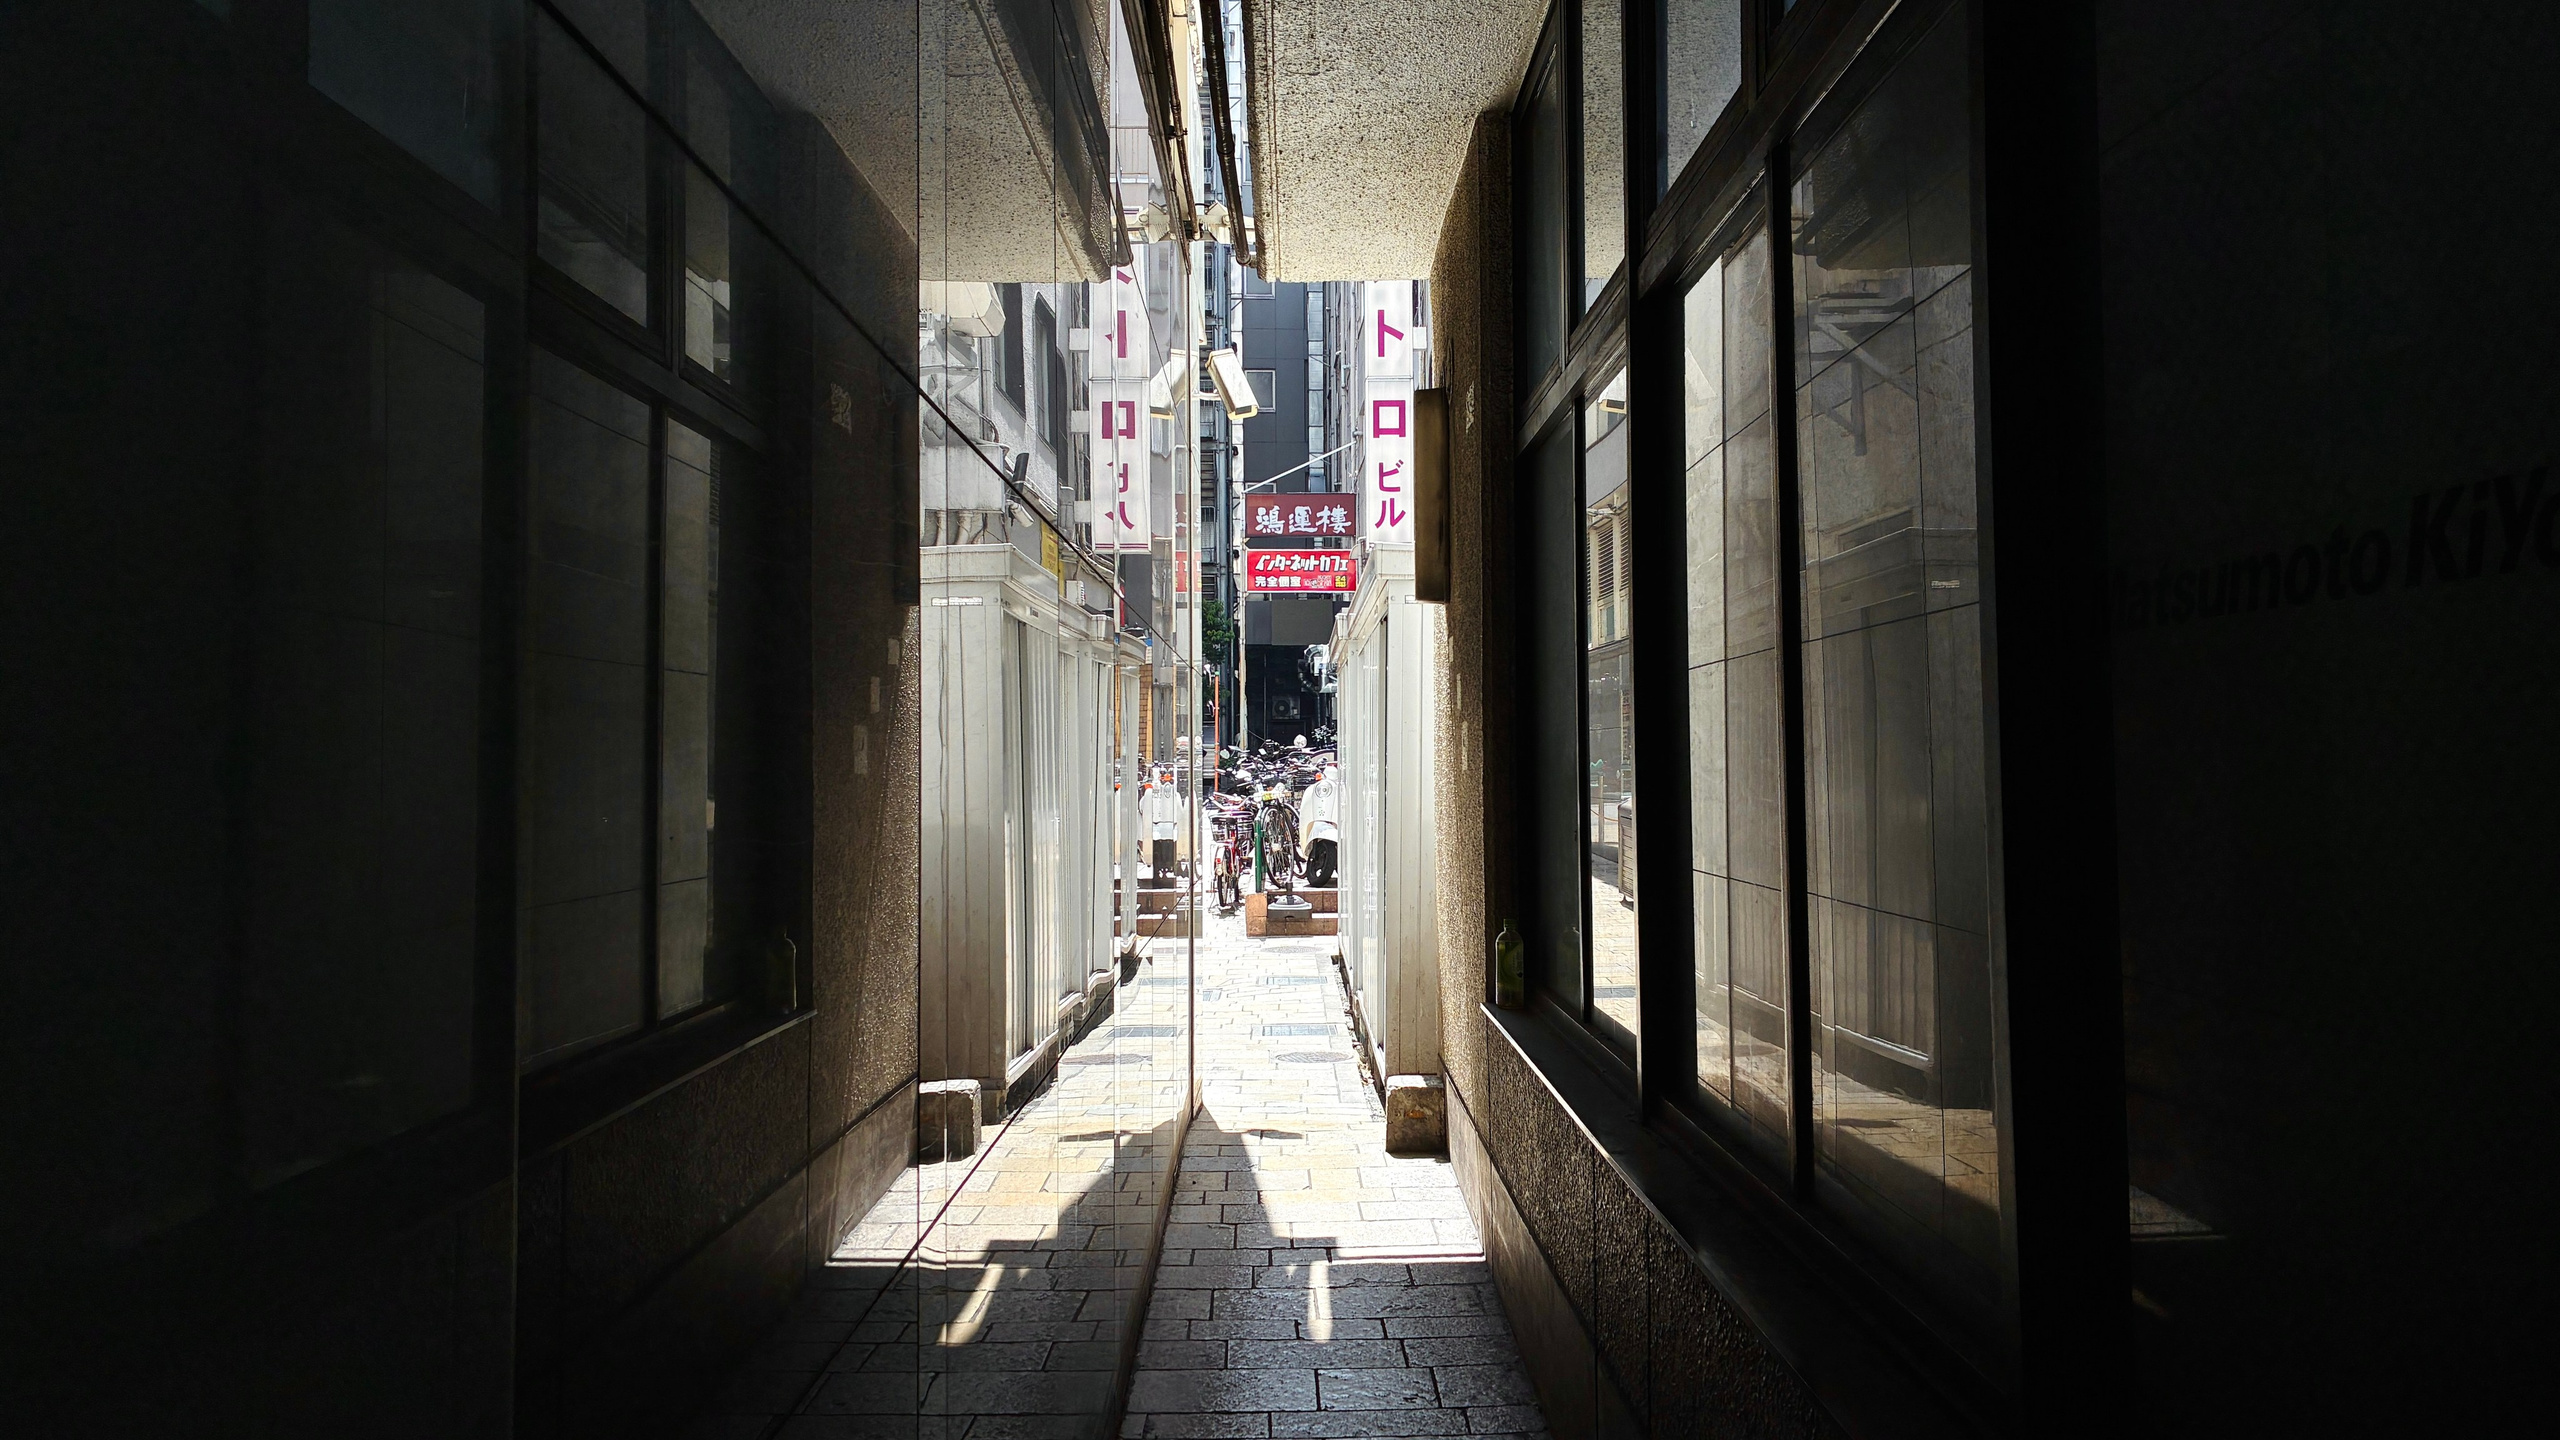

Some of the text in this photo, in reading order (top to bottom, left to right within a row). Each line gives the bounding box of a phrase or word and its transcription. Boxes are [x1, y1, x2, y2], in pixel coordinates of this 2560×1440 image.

[1255, 555, 1348, 571] インターネットカフェ
